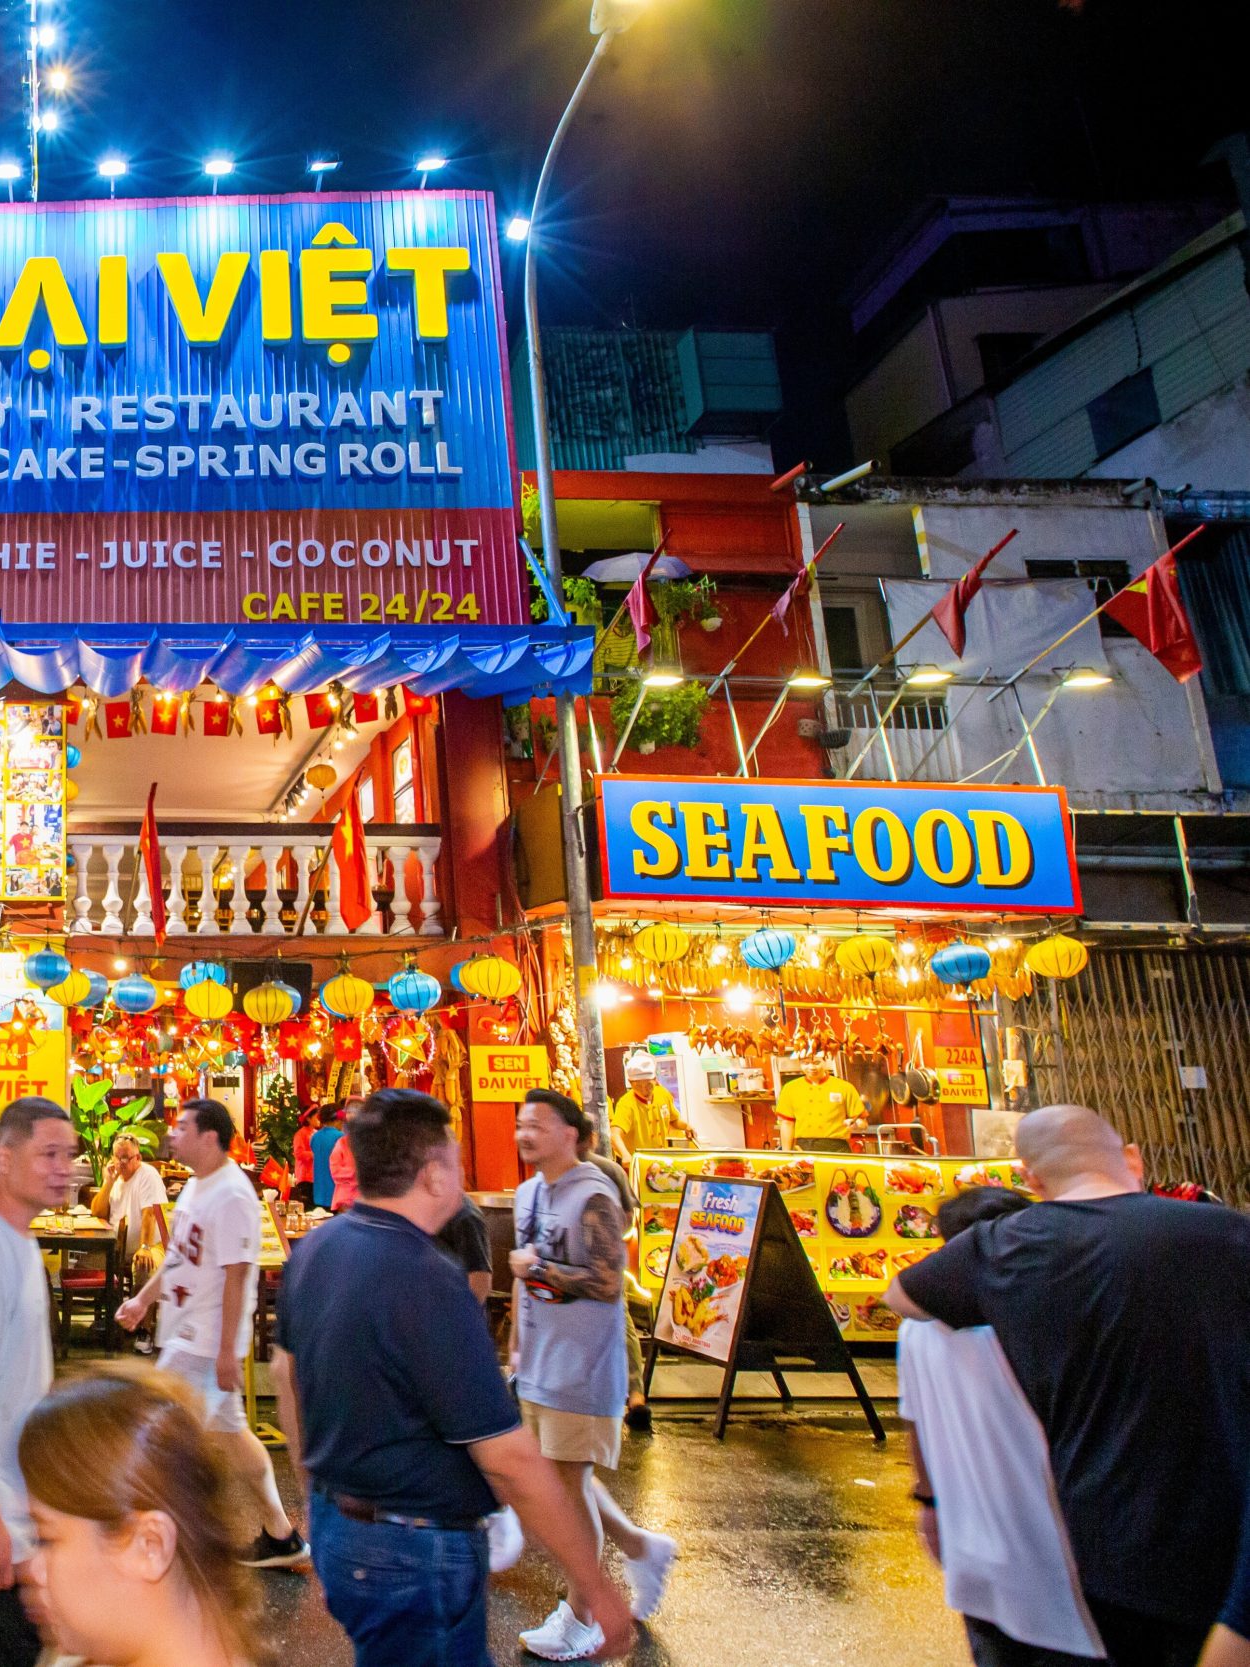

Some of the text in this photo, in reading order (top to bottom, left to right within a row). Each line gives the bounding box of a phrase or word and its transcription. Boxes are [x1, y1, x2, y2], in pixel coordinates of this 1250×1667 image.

[157, 222, 471, 367] VIỆT
[72, 390, 443, 433] RESTAURANT
[340, 442, 463, 477] ROLL
[100, 541, 222, 569] JUICE
[269, 539, 479, 568] COCONUT
[243, 590, 481, 623] CAFE 24/24
[630, 800, 1031, 887] SEAFOOD
[493, 1057, 525, 1071] SEN
[945, 1048, 978, 1064] 224A
[478, 1077, 505, 1092] ĐẠI
[703, 1191, 740, 1211] Fresh
[689, 1211, 747, 1235] SEAFOOD
